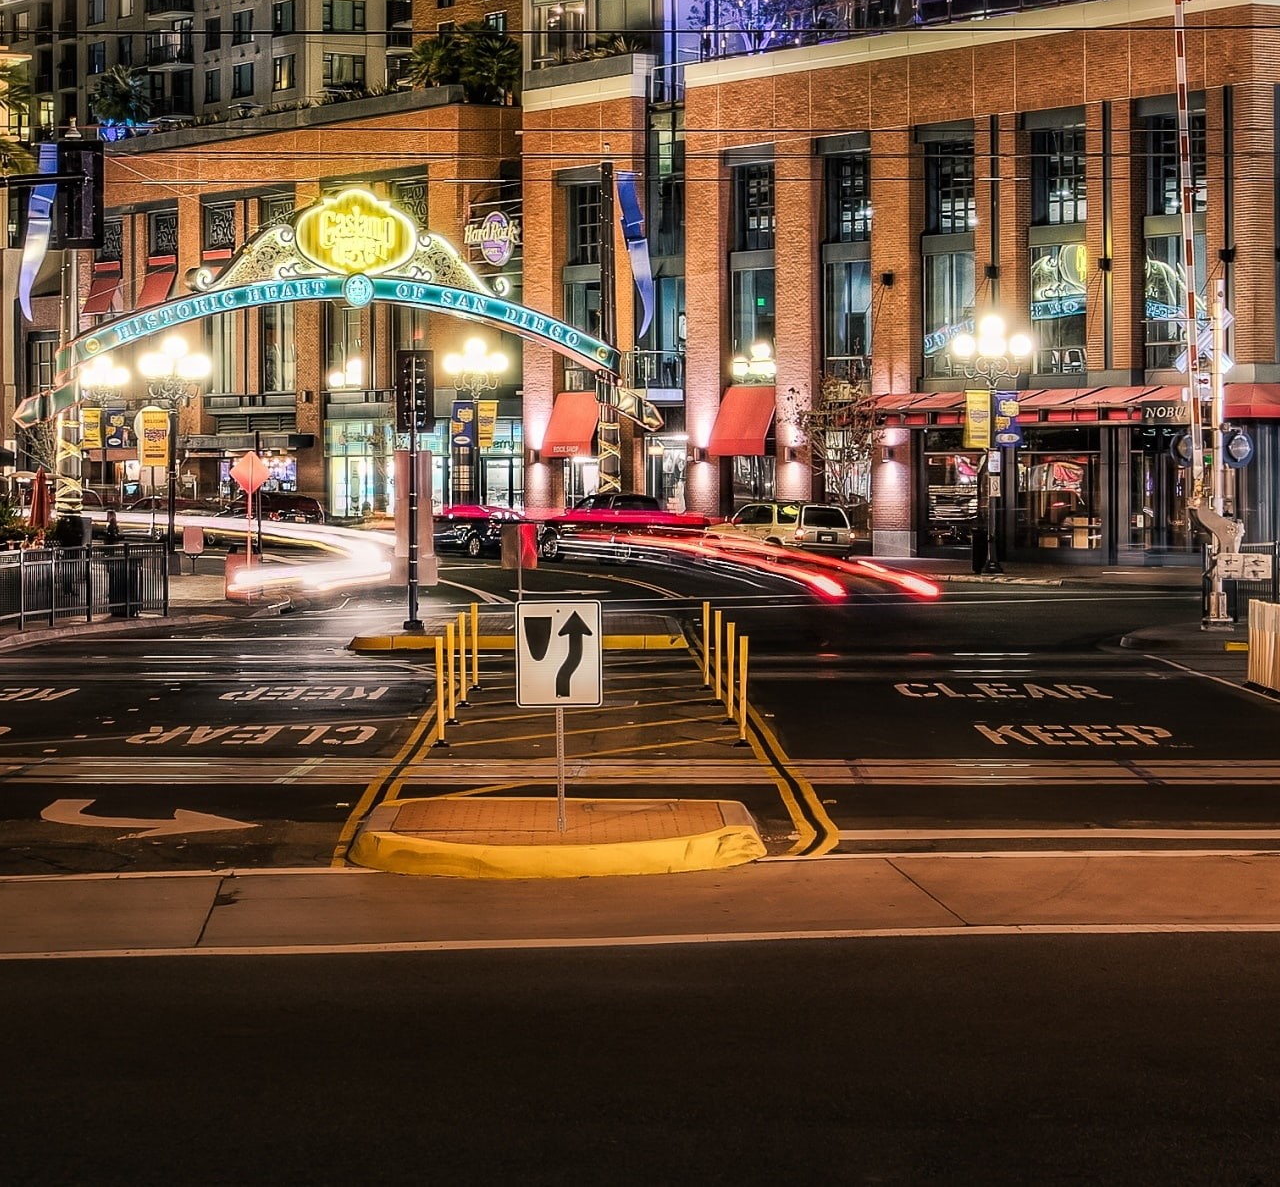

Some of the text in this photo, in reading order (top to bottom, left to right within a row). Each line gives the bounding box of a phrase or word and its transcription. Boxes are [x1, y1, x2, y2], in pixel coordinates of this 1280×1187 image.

[320, 205, 397, 250] Gaslamp
[464, 219, 521, 244] Hard Rock
[115, 281, 580, 346] HISTORIC HEART OF SAN DIEGO
[1145, 406, 1186, 418] NOBU
[218, 686, 389, 701] KEEP
[894, 683, 1113, 699] CLEAR
[125, 725, 378, 745] CLEAR
[974, 725, 1172, 746] KEEP
